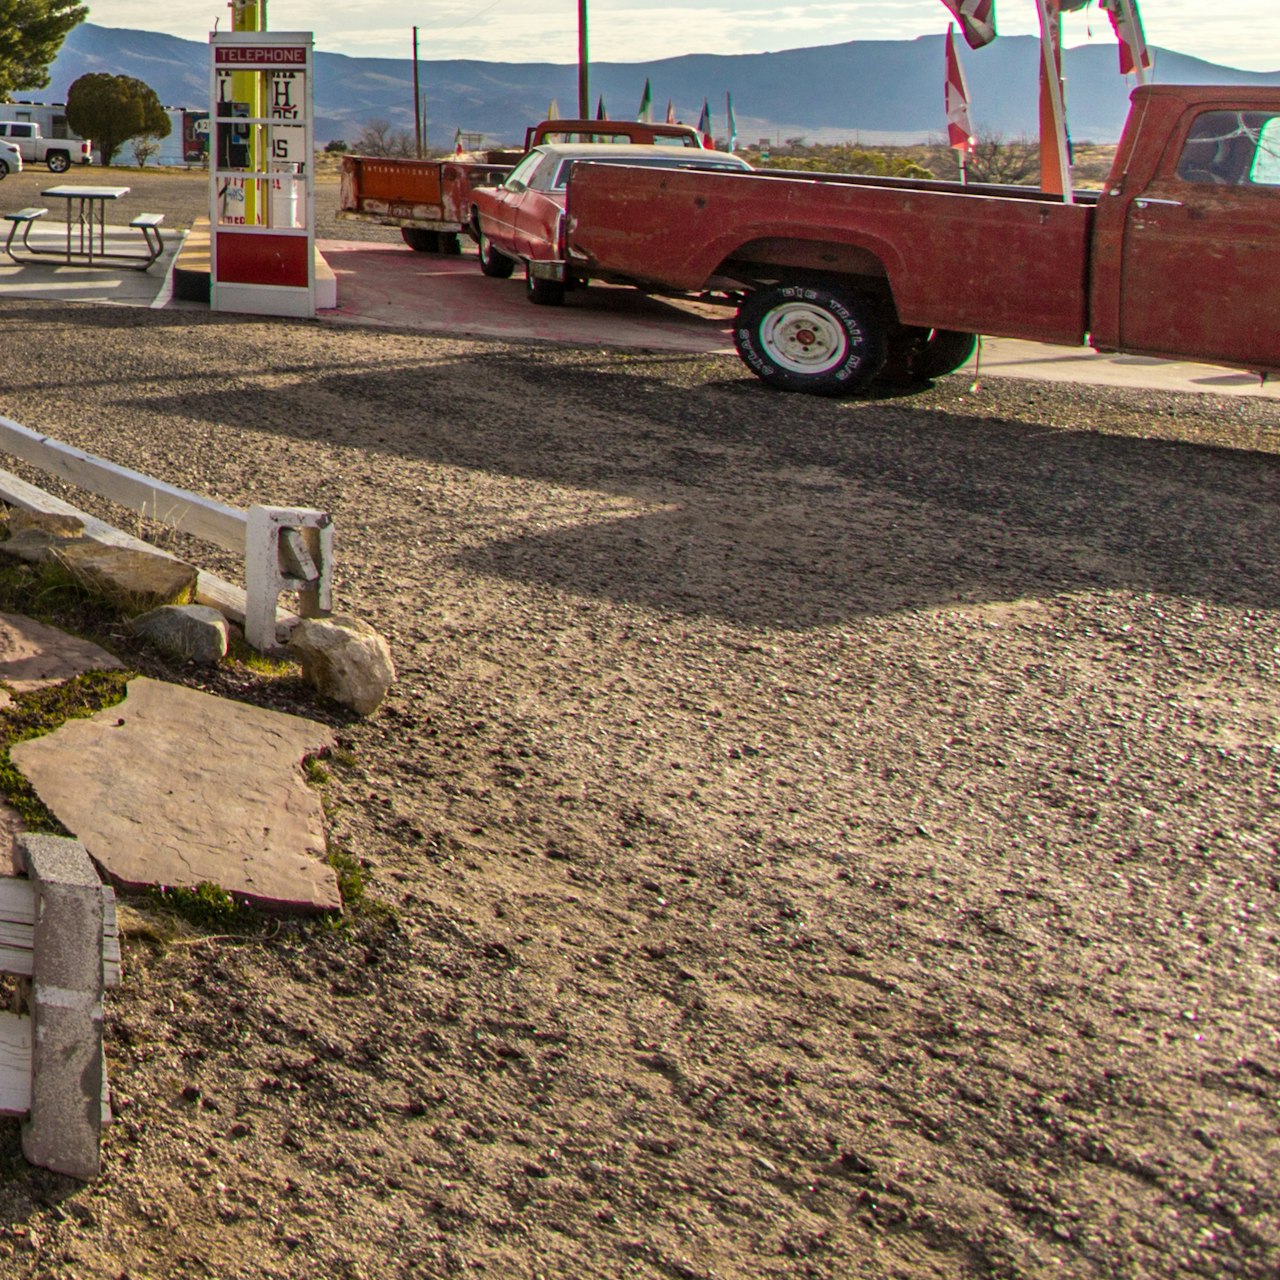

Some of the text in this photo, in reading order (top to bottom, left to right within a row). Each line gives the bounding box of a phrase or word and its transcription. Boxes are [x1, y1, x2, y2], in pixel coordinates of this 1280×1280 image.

[219, 49, 303, 62] TELEPHONE
[362, 166, 436, 176] INTERNATIONAL
[782, 287, 817, 300] BIG
[829, 299, 864, 347] TRAIL
[740, 329, 774, 376] ATLAS
